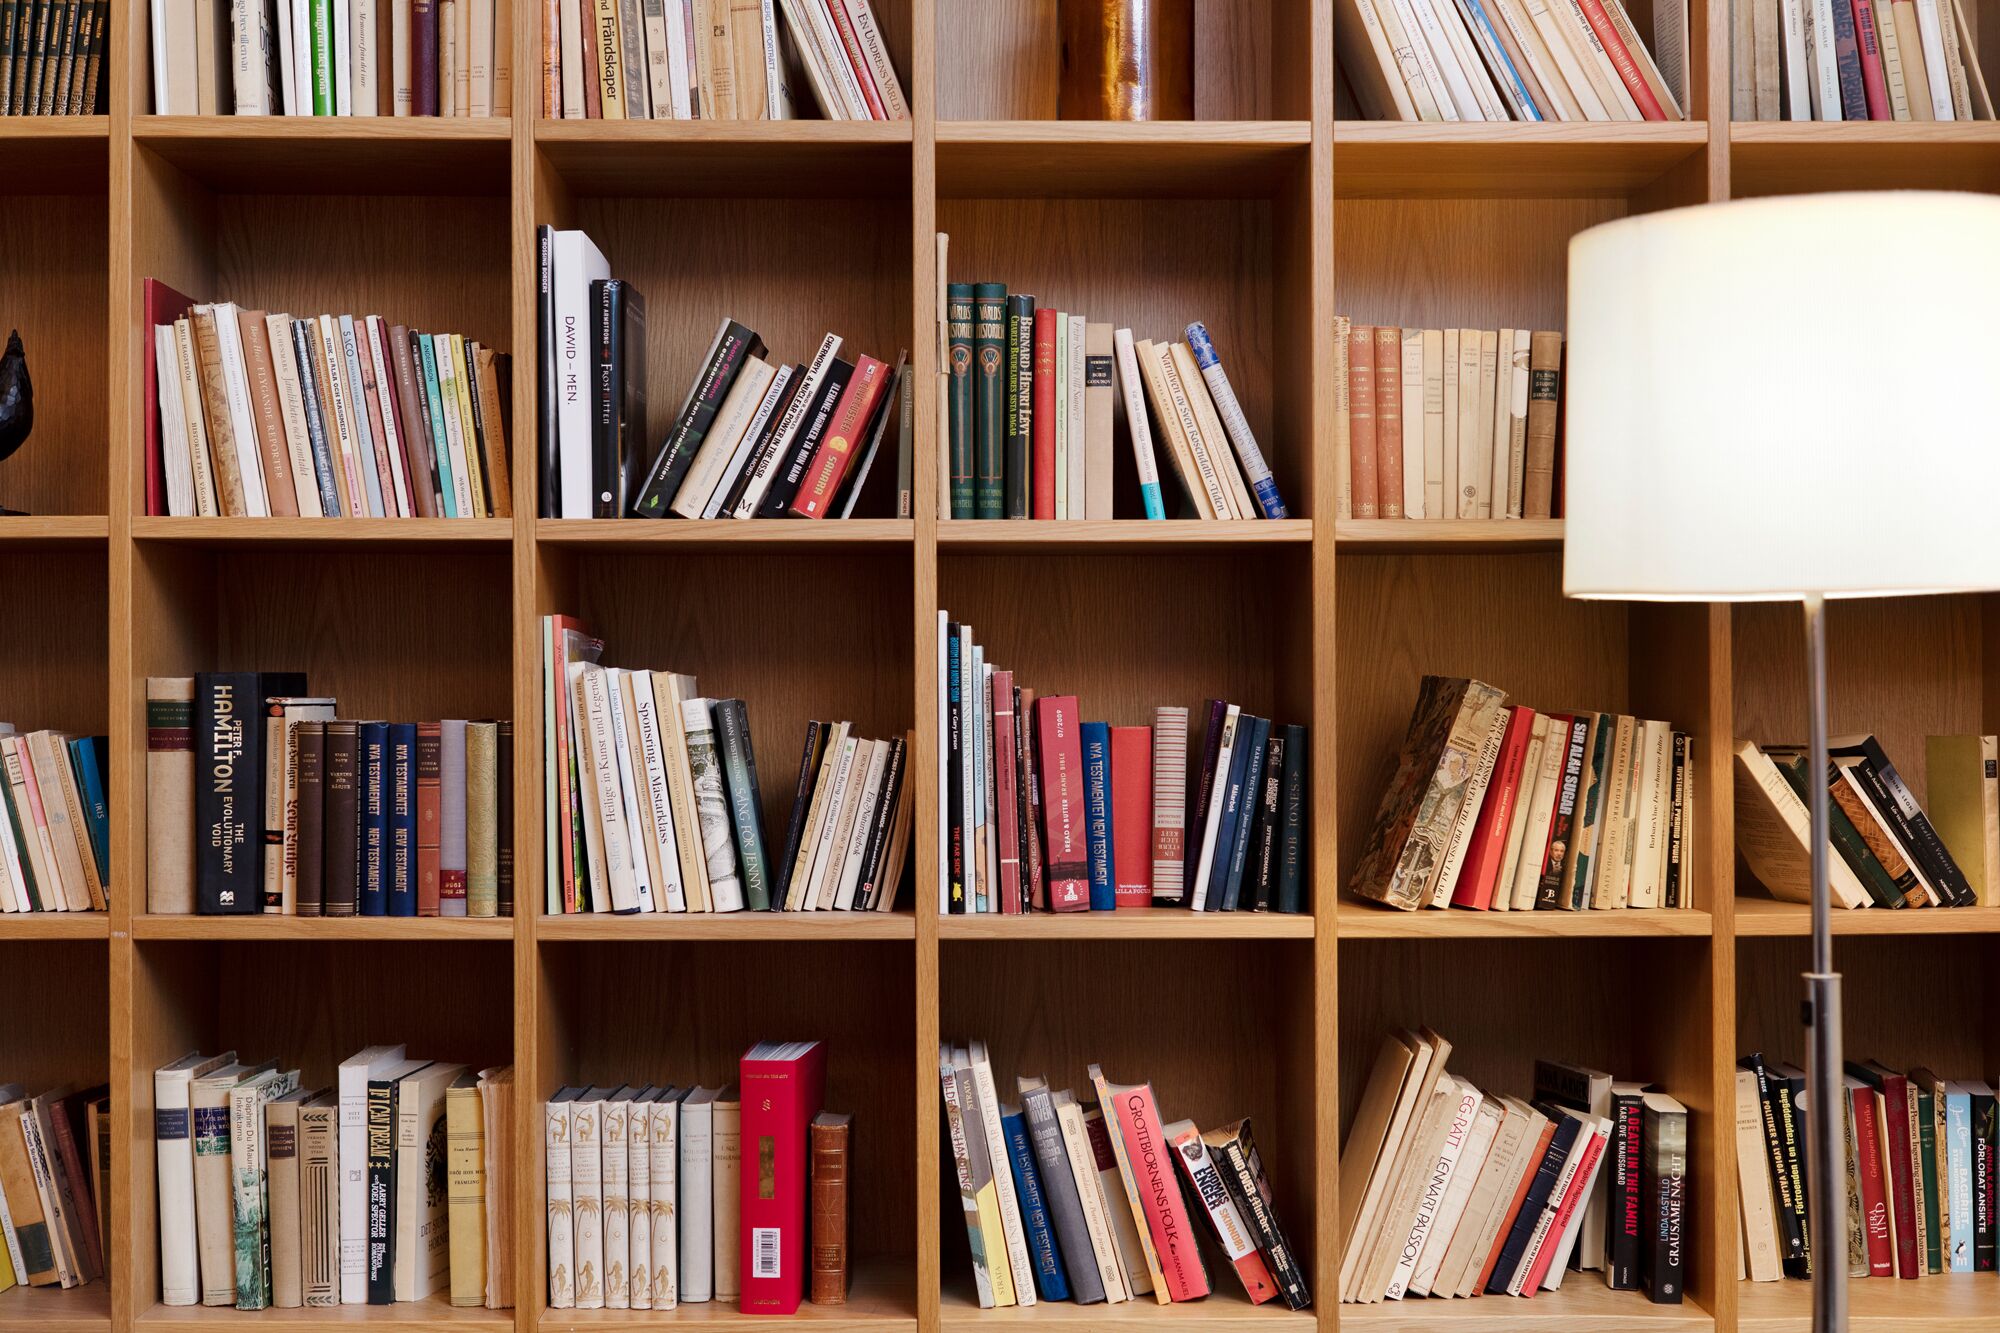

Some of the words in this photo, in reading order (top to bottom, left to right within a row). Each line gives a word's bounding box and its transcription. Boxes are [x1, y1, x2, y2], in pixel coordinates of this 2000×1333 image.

[601, 17, 620, 99] Frändskaper
[342, 331, 354, 357] SACO
[564, 316, 575, 358] DAWID
[723, 335, 734, 347] De
[422, 343, 434, 382] ANDERSSON
[808, 334, 835, 375] CHERNOBYL
[1009, 347, 1018, 392] BAUDELAIRES
[256, 366, 273, 420] FLYGANDE
[566, 374, 576, 405] MEN.
[788, 381, 811, 414] NUCLEAR
[1160, 352, 1181, 394] Varulven
[1175, 394, 1185, 406] av
[1180, 407, 1194, 429] Sven
[335, 399, 347, 440] MASSMEDIA
[684, 415, 695, 427] de
[690, 401, 701, 416] van
[775, 412, 794, 439] POWER
[656, 425, 689, 481] priemgetallen
[753, 431, 771, 458] SVENSKA
[763, 445, 777, 460] THE
[771, 437, 781, 446] IN
[743, 456, 758, 477] MORD
[753, 458, 770, 479] USSR
[795, 448, 809, 465] MIN
[786, 463, 802, 483] HAND
[812, 454, 838, 496] SAHARA
[961, 662, 969, 689] STORA
[232, 720, 242, 747] PETER
[724, 708, 734, 736] STAFFAN
[962, 692, 971, 758] TENNISBOKEN
[1571, 722, 1587, 744] SIR
[212, 685, 232, 792] HAMILTON
[367, 744, 380, 760] NYA
[394, 744, 407, 760] NYA
[1088, 742, 1101, 758] NYA
[232, 750, 242, 758] F.
[729, 738, 742, 782] WESTERLUND
[840, 754, 850, 775] Matts
[1478, 742, 1499, 790] JOHANSSON
[1565, 743, 1583, 774] ALAN
[637, 701, 658, 764] Sponsring
[651, 775, 670, 844] Mästarklass
[1059, 772, 1067, 795] BRAND
[1674, 766, 1683, 806] MYSTERIOUS
[367, 762, 380, 814] TESTAMENTET
[394, 762, 407, 815] TESTAMENTET
[1089, 761, 1104, 816] TESTAMENTET
[1227, 784, 1239, 812] Målarbok
[1464, 778, 1478, 807] GATAN
[1558, 774, 1578, 815] SUGAR
[94, 802, 104, 818] IRIS
[734, 786, 752, 820] SÅNG
[1061, 799, 1069, 822] BUTTER
[1900, 794, 1914, 812] LEON
[823, 824, 832, 840] idag
[851, 801, 873, 856] Naturdagbok
[1092, 818, 1105, 837] NEW
[1458, 809, 1468, 827] TILL
[1673, 808, 1681, 838] PYRAMID
[212, 823, 222, 846] VOID
[222, 796, 232, 874] EVOLUTIONARY
[234, 823, 244, 843] THE
[367, 828, 380, 846] NEW
[394, 828, 406, 846] NEW
[740, 823, 756, 848] FÖR
[1063, 830, 1071, 852] BREAD
[1446, 829, 1462, 865] PRESSEN
[1093, 839, 1107, 885] TESTAMENT
[1287, 836, 1297, 864] BOB
[1671, 840, 1679, 863] POWER
[366, 848, 380, 891] TESTAMENT
[394, 848, 406, 892] TESTAMENT
[743, 850, 762, 892] JENNY
[960, 1079, 976, 1110] STRATA
[1907, 1087, 1917, 1109] Ingvar
[243, 1096, 253, 1125] Daphne
[1618, 1106, 1626, 1122] KARL
[1761, 1099, 1777, 1137] POLITIKER
[1777, 1088, 1795, 1145] trappuppgång
[1864, 1104, 1872, 1127] Afrika
[1910, 1110, 1918, 1139] Persson
[20, 1118, 29, 1133] Jean
[23, 1132, 33, 1147] Piaget
[245, 1127, 254, 1141] Du
[1618, 1124, 1626, 1136] OVE
[1627, 1117, 1639, 1152] DEATH
[1866, 1129, 1873, 1137] in
[1013, 1134, 1024, 1150] NYA
[1592, 1143, 1603, 1157] Jan
[1787, 1146, 1796, 1157] en
[28, 1147, 44, 1188] Strukturalismen
[246, 1144, 254, 1174] Maurier
[1226, 1144, 1245, 1172] MIND
[1238, 1169, 1257, 1196] OVER
[1617, 1141, 1626, 1184] KNAUSGAARD
[1626, 1156, 1638, 1168] IN
[1772, 1147, 1785, 1173] LYDIGA
[1867, 1139, 1878, 1177] Gefangen
[1910, 1141, 1920, 1177] Ingenting
[1977, 1138, 1986, 1189] FÖRLORAT
[1017, 1152, 1039, 1208] TESTAMENTET
[1192, 1166, 1221, 1211] ENGER
[1204, 1161, 1229, 1205] THOMAS
[1419, 1156, 1453, 1214] LENNART
[1626, 1172, 1638, 1192] THE
[1669, 1153, 1682, 1197] NACHT
[1789, 1164, 1804, 1214] Förtroenden
[378, 1183, 386, 1206] LARRY
[1660, 1178, 1670, 1215] CASTILLO
[1777, 1174, 1793, 1207] VÄLJARE
[370, 1201, 378, 1236] SPECTOR
[378, 1208, 386, 1237] GELLER
[1030, 1209, 1045, 1228] NEW
[1159, 1207, 1178, 1242] FOLK
[1559, 1212, 1571, 1227] land
[1624, 1196, 1638, 1236] FAMILY
[1869, 1209, 1878, 1233] HERA
[1874, 1202, 1887, 1238] LIND
[1916, 1212, 1921, 1224] om
[1978, 1192, 1986, 1232] ANSIKTE
[1398, 1212, 1432, 1268] PÅLSSON
[1660, 1218, 1668, 1240] LINDA
[1666, 1200, 1681, 1266] GRAUSAME
[1034, 1228, 1056, 1276] TESTAMENT
[1916, 1226, 1927, 1265] Johansson
[1172, 1255, 1181, 1272] JEAN
[1178, 1278, 1189, 1297] AUEL
